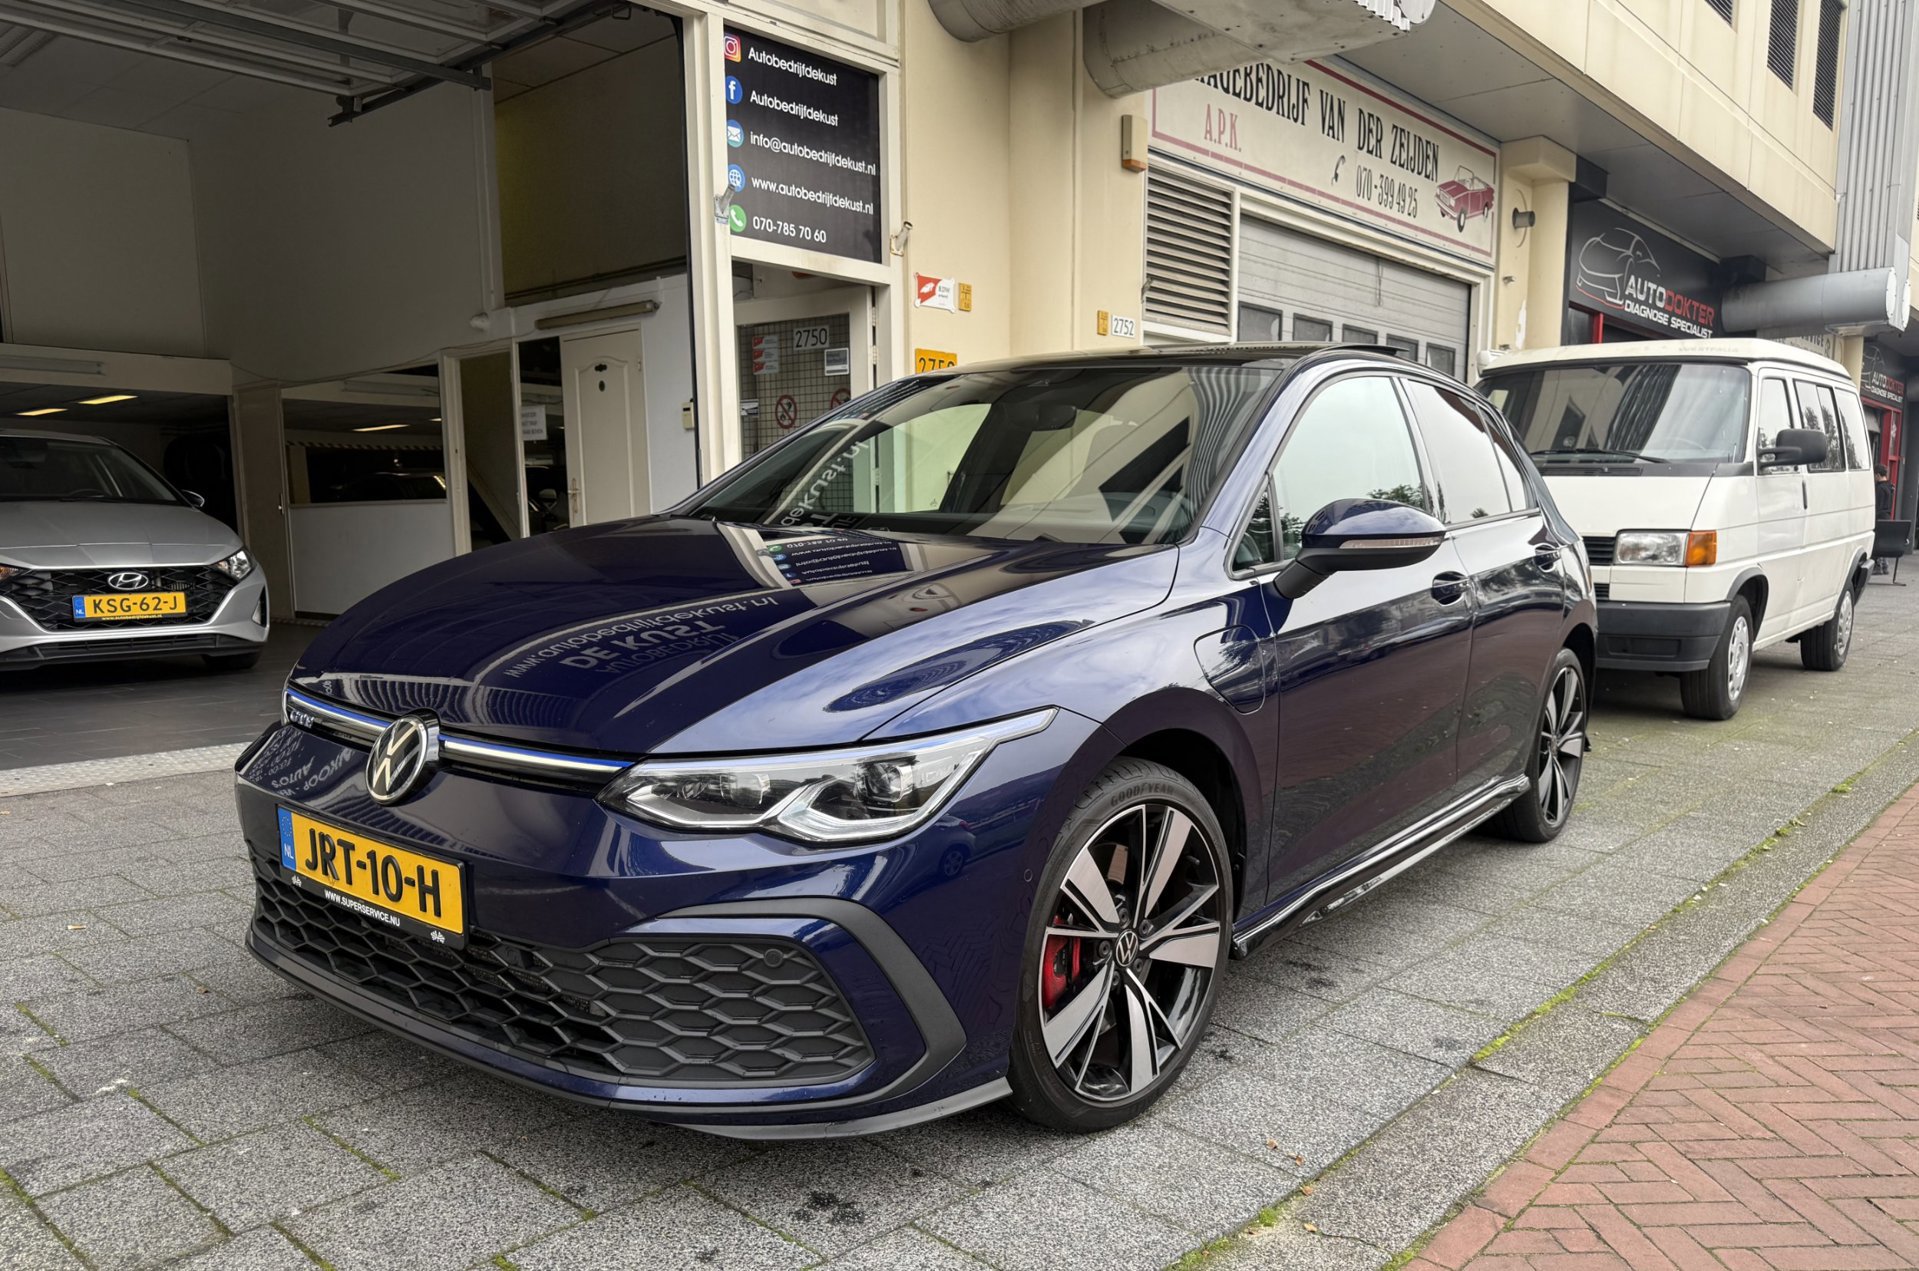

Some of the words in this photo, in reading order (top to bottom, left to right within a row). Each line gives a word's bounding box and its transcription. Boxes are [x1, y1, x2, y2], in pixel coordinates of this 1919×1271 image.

[748, 47, 837, 86] Autobedrijfdekust
[750, 90, 839, 127] Autobedrijfdekust
[1204, 103, 1242, 153] A.P.K.
[750, 131, 876, 176] info@autobedrijfdekust.nl
[1320, 89, 1345, 143] VAN
[1357, 107, 1383, 159] DER
[1390, 123, 1439, 182] ZEIJDEN
[751, 176, 874, 216] www.autobedrijfdekust.nl
[752, 216, 796, 238] 070-785
[799, 225, 812, 241] 70
[813, 229, 827, 244] 60
[1624, 300, 1669, 326] DIAGNOSE
[1670, 317, 1713, 338] SPECIALIST
[1625, 274, 1715, 327] AUTODOKTER
[795, 327, 828, 349] 2750
[1113, 317, 1134, 336] 2752
[93, 596, 177, 614] KSG-62-J
[284, 843, 294, 860] NL
[305, 828, 442, 918] JRT-10-H
[324, 889, 401, 928] WWW.SUPERSERVICE.NU
